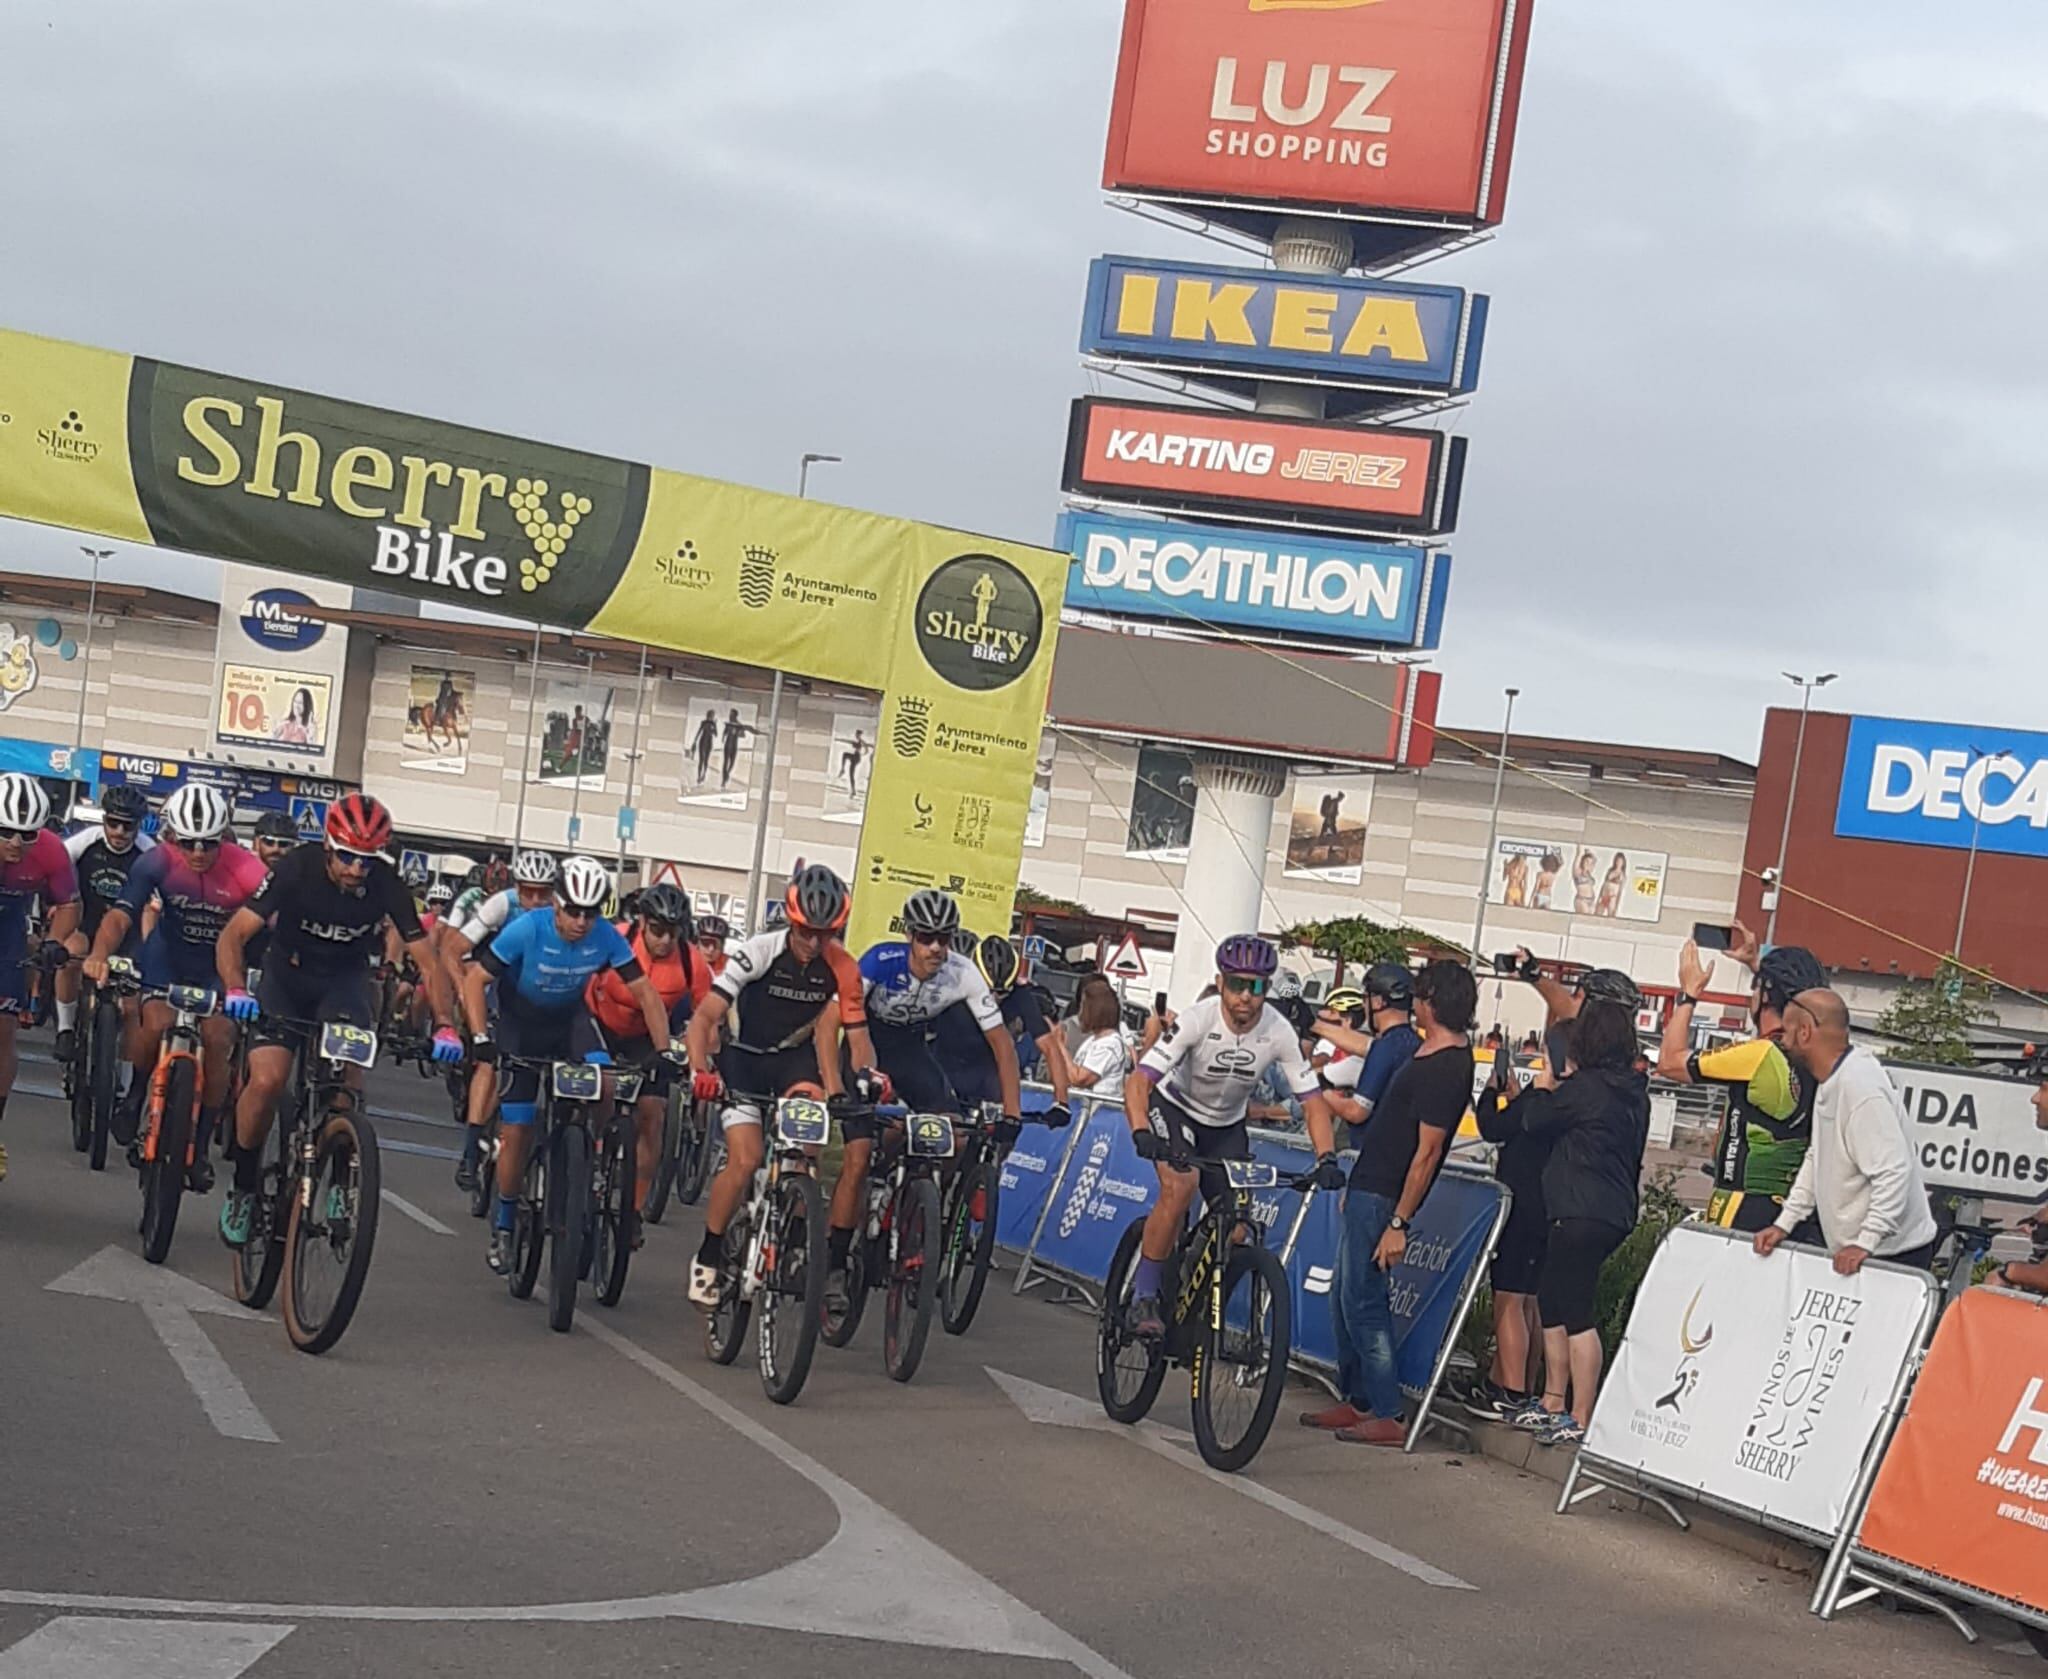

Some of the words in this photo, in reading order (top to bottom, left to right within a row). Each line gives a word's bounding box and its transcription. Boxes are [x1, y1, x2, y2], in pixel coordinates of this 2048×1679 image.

[1210, 57, 1398, 133] LUZ
[1205, 129, 1388, 168] SHOPPING
[1116, 274, 1429, 363] IKEA
[36, 428, 102, 457] Sherry
[1105, 429, 1275, 475] KARTING
[1280, 448, 1408, 489] JEREZ
[177, 395, 593, 592] Sherry
[370, 526, 508, 596] Bike
[655, 556, 715, 583] Sherry
[1083, 533, 1403, 620] DECATHLON
[781, 586, 798, 600] de
[800, 589, 835, 607] Jerez
[783, 572, 878, 602] Ayuntamiento
[925, 610, 1029, 663] Sherry
[971, 644, 1008, 664] Bike
[934, 735, 950, 749] de
[952, 737, 986, 756] Jerez
[936, 722, 1028, 751] Ayuntamiento
[1867, 743, 2048, 829] DECA
[785, 1106, 823, 1123] 122
[917, 1122, 943, 1138] 45
[1914, 1137, 2048, 1183] cciones
[1388, 1277, 1421, 1318] ádiz
[1790, 1288, 1863, 1326] JEREZ
[1752, 1348, 1792, 1421] VINOS
[1783, 1325, 1797, 1345] DE
[1791, 1347, 1845, 1450] WINES
[1734, 1439, 1801, 1482] SHERRY
